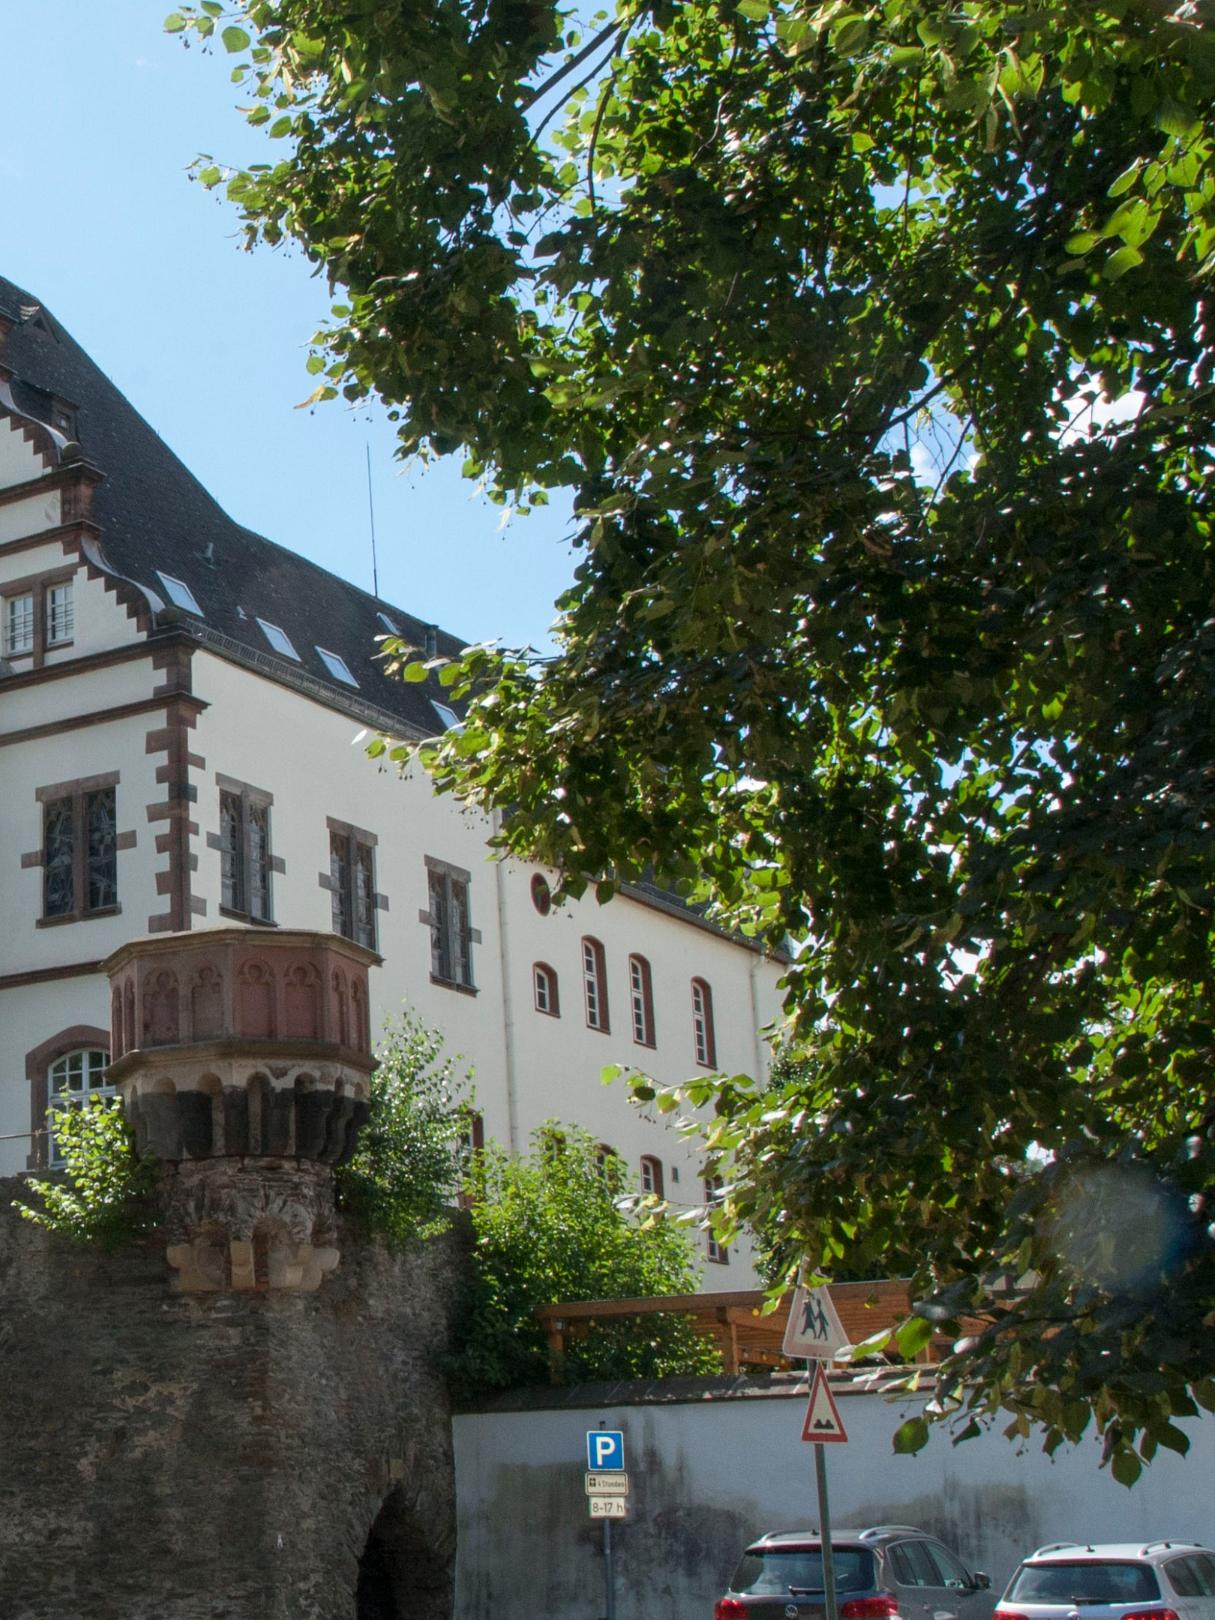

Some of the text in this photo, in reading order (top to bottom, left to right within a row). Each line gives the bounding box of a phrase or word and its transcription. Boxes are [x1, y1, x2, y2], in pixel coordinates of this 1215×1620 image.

[596, 1436, 616, 1466] P
[592, 1502, 624, 1513] 8-17 h
